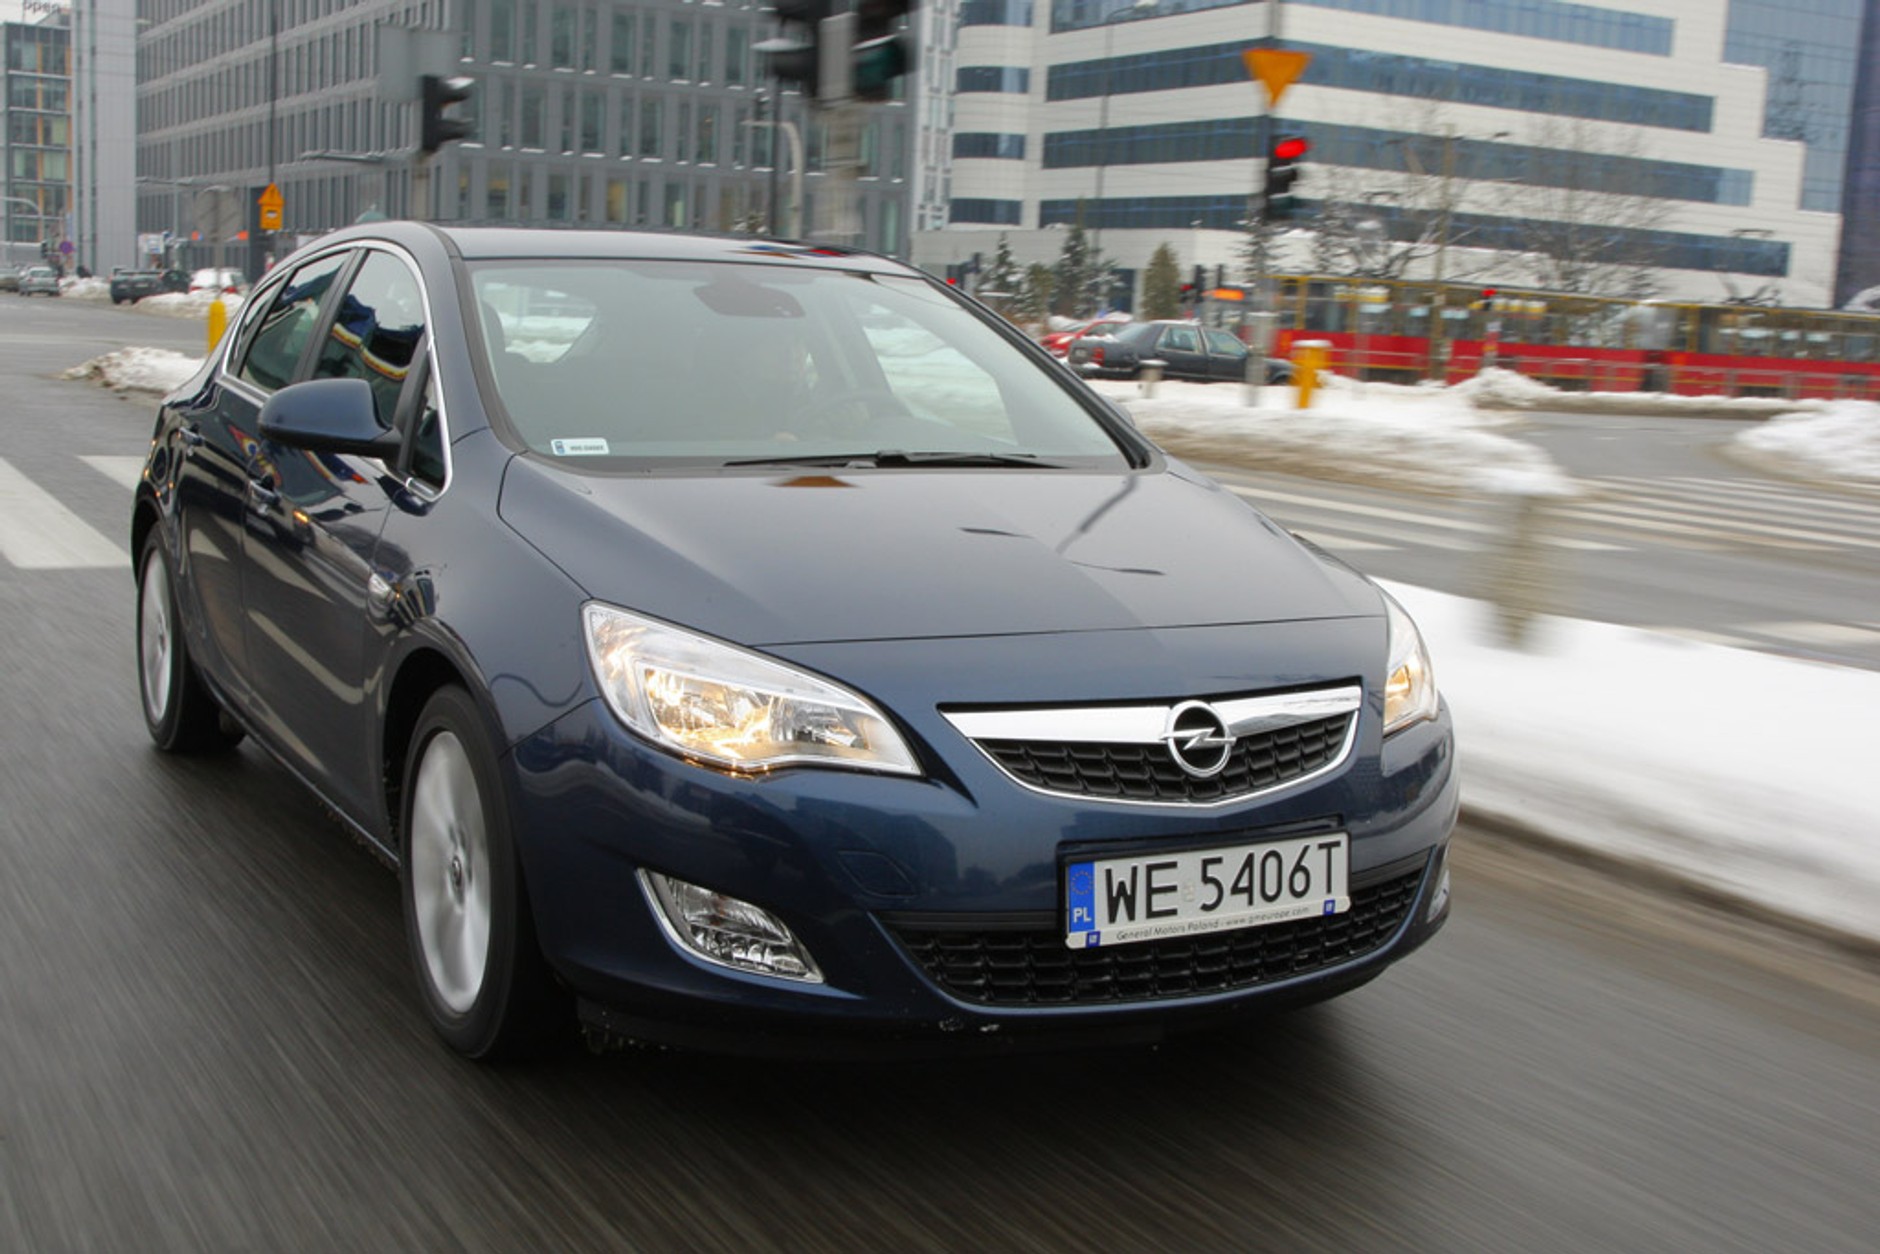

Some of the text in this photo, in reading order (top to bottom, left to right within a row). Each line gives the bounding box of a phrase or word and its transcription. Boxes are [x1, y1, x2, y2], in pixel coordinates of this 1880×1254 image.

[1105, 841, 1341, 924] WE 5406T
[1073, 906, 1092, 923] PL
[1116, 927, 1152, 941] General
[1153, 924, 1185, 936] Motors
[1188, 919, 1219, 930] Poland
